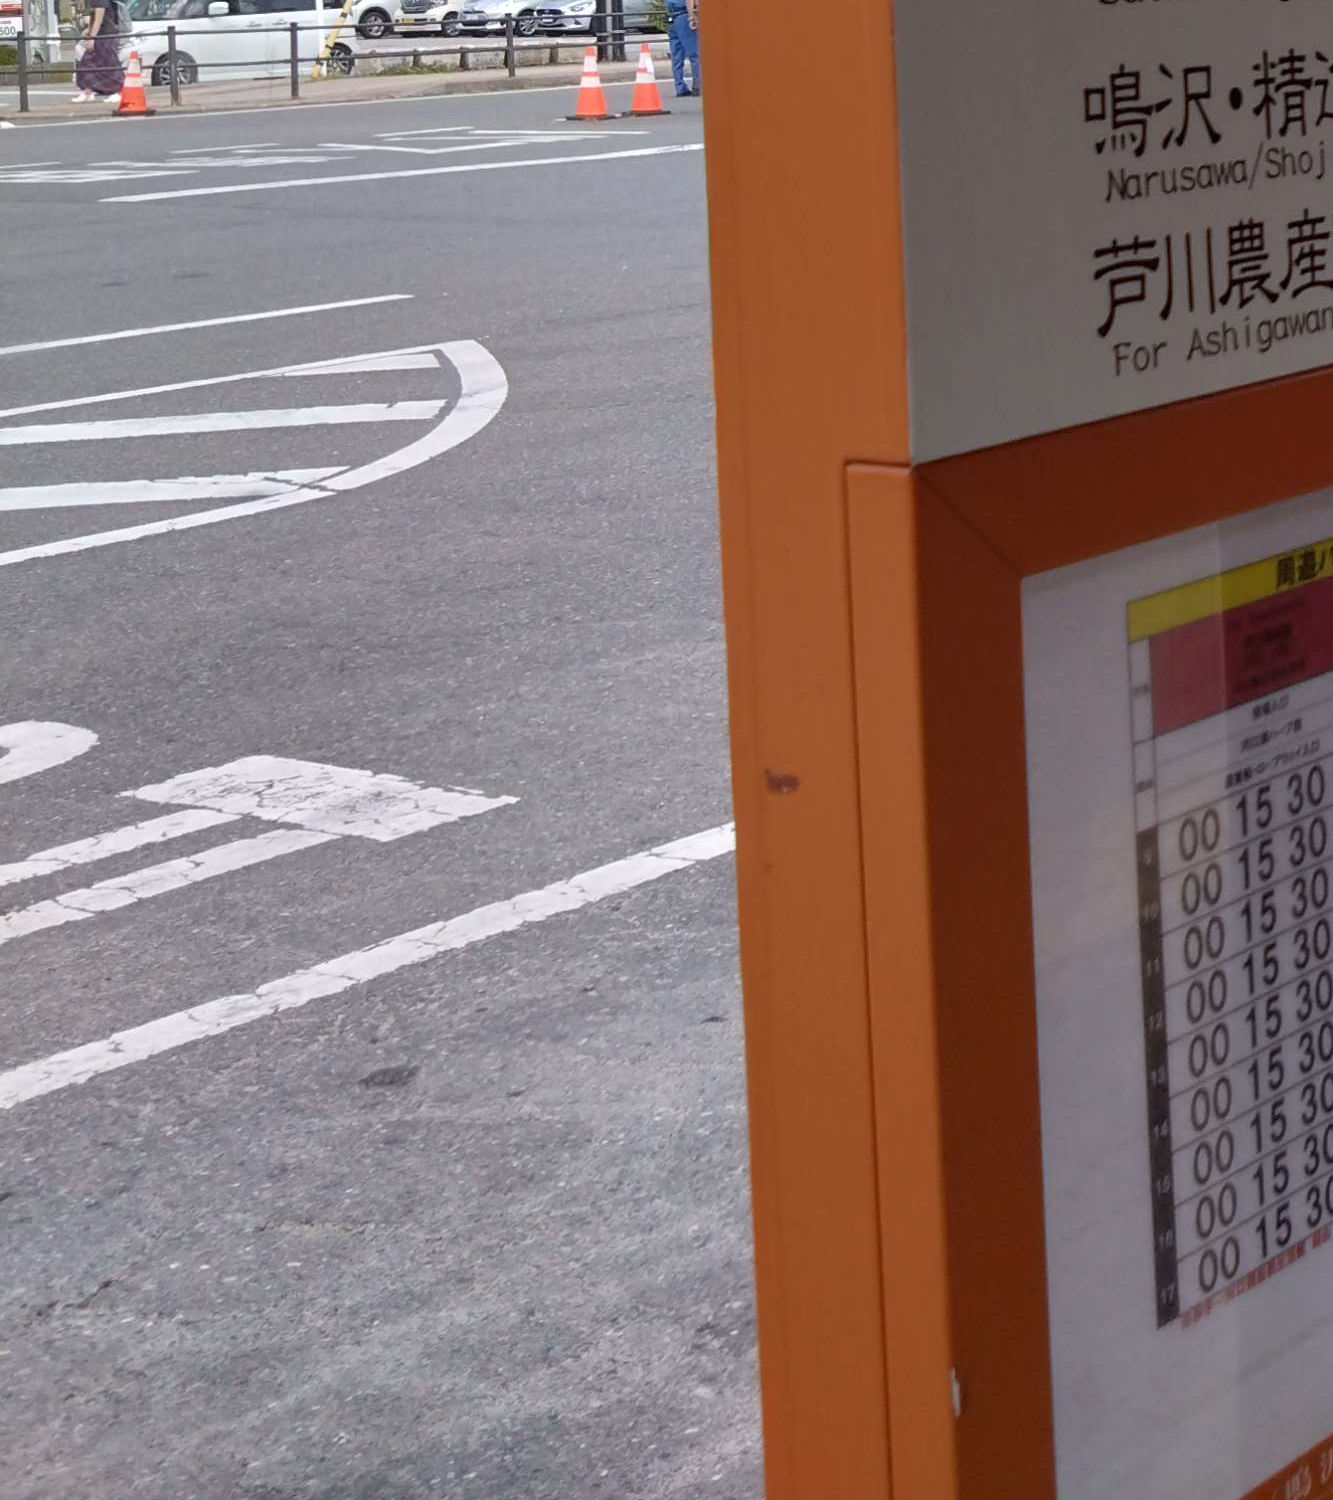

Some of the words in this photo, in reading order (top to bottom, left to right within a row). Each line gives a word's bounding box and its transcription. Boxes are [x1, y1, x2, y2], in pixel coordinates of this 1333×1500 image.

[1114, 338, 1167, 377] For
[1178, 807, 1221, 863] 00
[1235, 783, 1273, 838] 15
[1287, 764, 1326, 817] 30
[1180, 861, 1223, 917] 00
[1237, 835, 1275, 891] 15
[1289, 815, 1328, 868] 30
[1183, 915, 1226, 971] 00
[1240, 888, 1277, 943] 15
[1291, 866, 1329, 920] 30
[1186, 967, 1228, 1025] 00
[1242, 940, 1280, 996] 15
[1293, 917, 1332, 971] 30
[1188, 1021, 1230, 1079] 00
[1245, 992, 1283, 1049] 15
[1295, 969, 1333, 1023] 30
[1190, 1074, 1233, 1133] 00
[1247, 1044, 1285, 1101] 15
[1192, 1128, 1235, 1187] 00
[1250, 1096, 1288, 1154] 15
[1195, 1181, 1238, 1240] 00
[1252, 1149, 1290, 1207] 15
[1198, 1235, 1241, 1294] 00
[1255, 1200, 1292, 1259] 15
